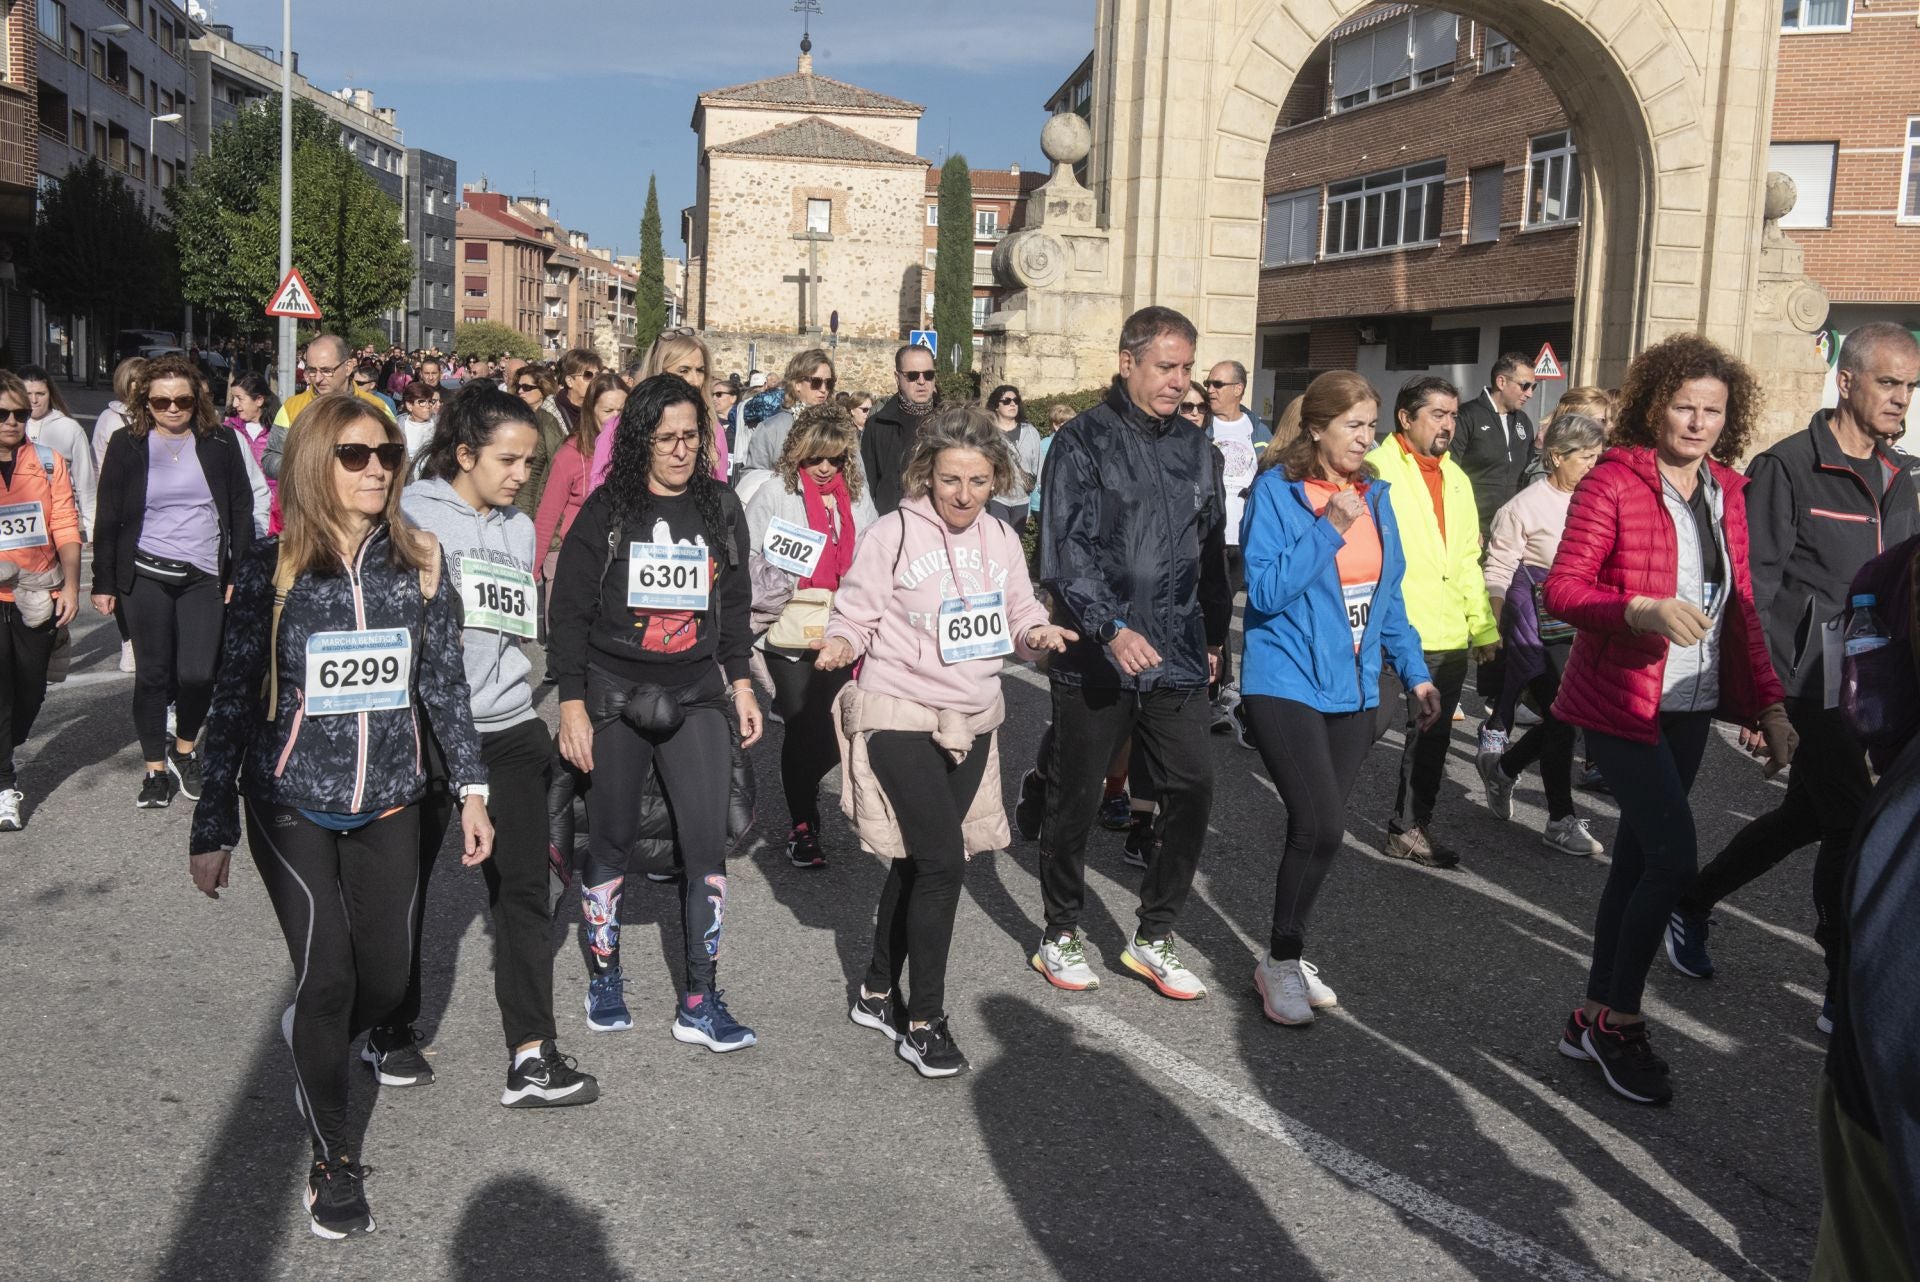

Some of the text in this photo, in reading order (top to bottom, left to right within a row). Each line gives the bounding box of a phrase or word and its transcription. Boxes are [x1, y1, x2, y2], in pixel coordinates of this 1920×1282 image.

[0, 516, 37, 536] 337
[768, 534, 813, 563] 2502
[639, 564, 698, 589] 6301
[899, 546, 1009, 590] UNIVERSTA
[474, 582, 526, 617] 1853
[948, 612, 1002, 641] 6300
[321, 637, 357, 646] MARCHA
[319, 656, 399, 688] 6299
